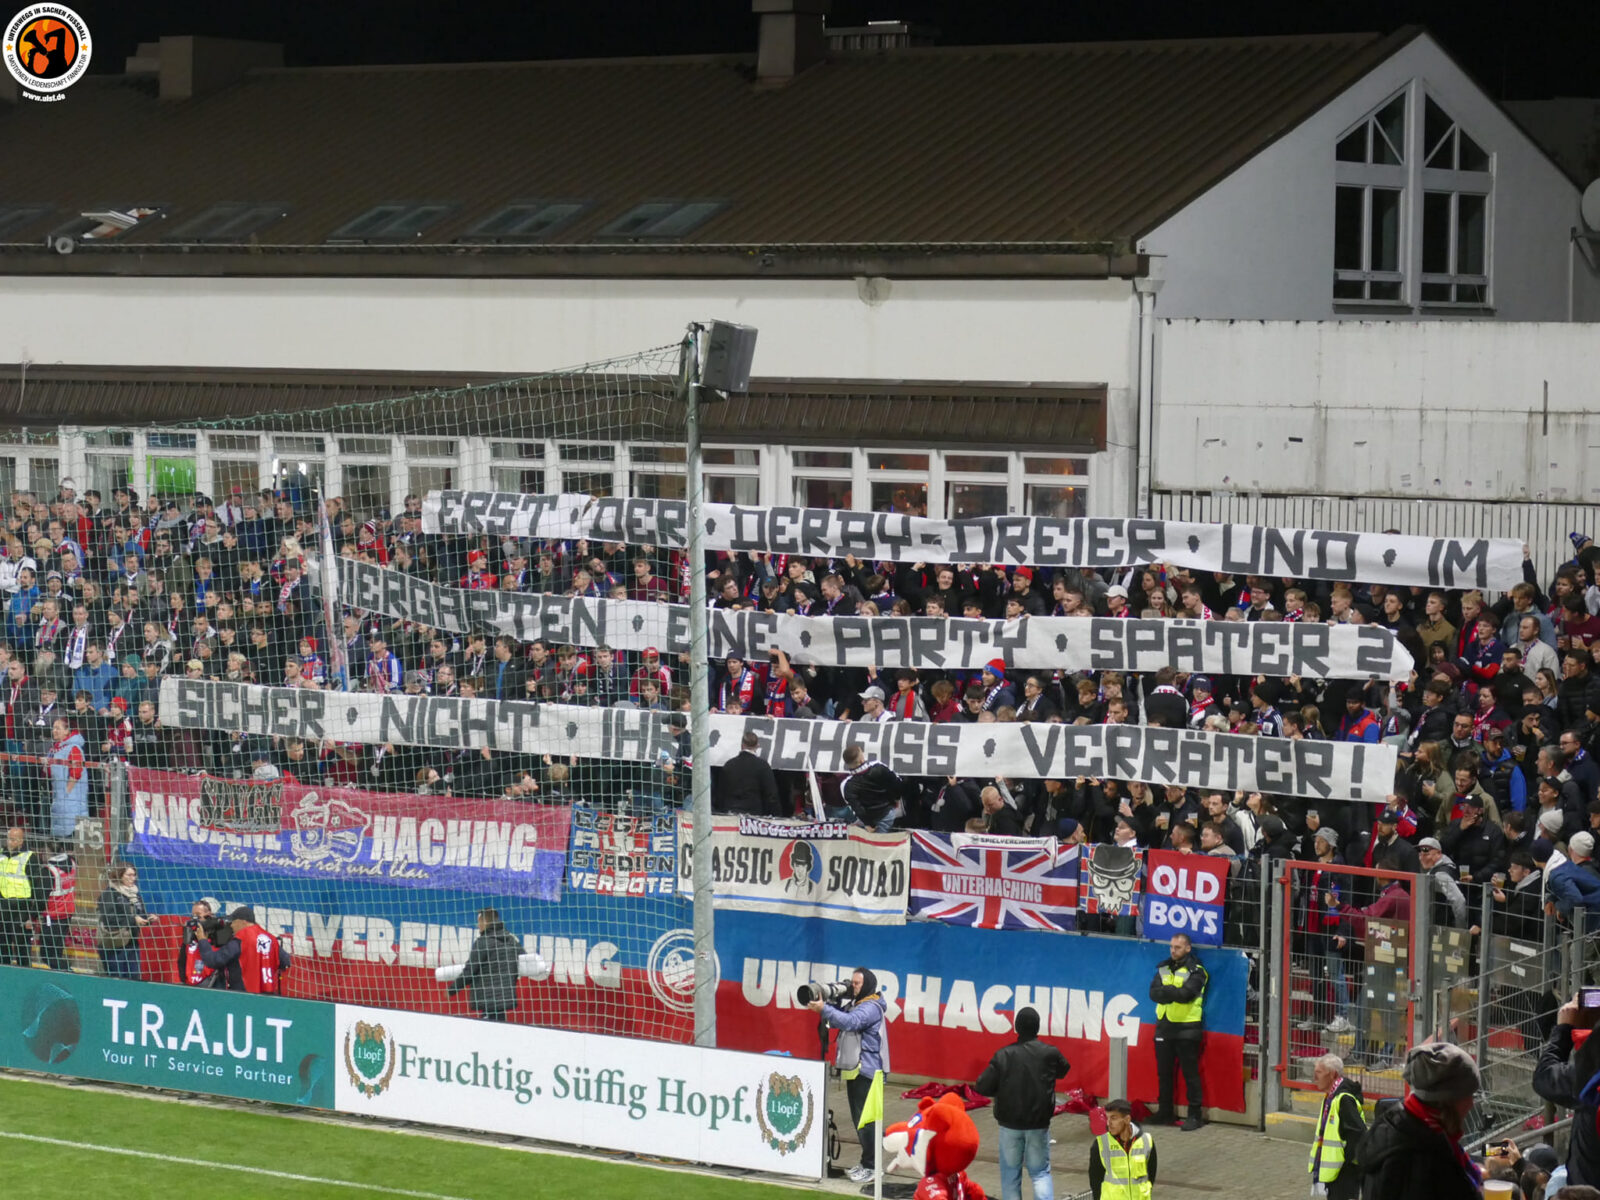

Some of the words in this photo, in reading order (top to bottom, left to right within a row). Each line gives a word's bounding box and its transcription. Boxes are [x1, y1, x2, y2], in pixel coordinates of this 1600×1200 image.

[440, 491, 557, 535] ERST
[588, 496, 690, 549] DER
[1222, 523, 1360, 580] UND
[1428, 538, 1489, 588] IM
[335, 558, 607, 646] IERGARTEN
[833, 617, 1027, 668] PARTY
[177, 680, 325, 739] SICHER
[380, 696, 539, 751] NICHT
[134, 791, 282, 851] FANS
[370, 815, 538, 872] HACHING
[574, 810, 674, 833] GEGEN
[574, 831, 675, 853] ALLE
[572, 851, 674, 873] STADION
[680, 843, 773, 886] CASSIC
[827, 855, 905, 897] SQUAD
[570, 871, 675, 894] VERBOTE
[942, 874, 1042, 903] UNTERHACHING
[1152, 865, 1220, 902] OLD
[1149, 901, 1218, 935] BOYS
[103, 998, 293, 1063] T.R.A.U.T
[103, 1049, 134, 1066] Your
[145, 1053, 158, 1069] IT
[168, 1058, 224, 1077] Service
[235, 1066, 293, 1085] Partner
[398, 1043, 541, 1105] Fruchtig.
[552, 1063, 648, 1120] Süffig
[657, 1077, 752, 1131] Hopf.
